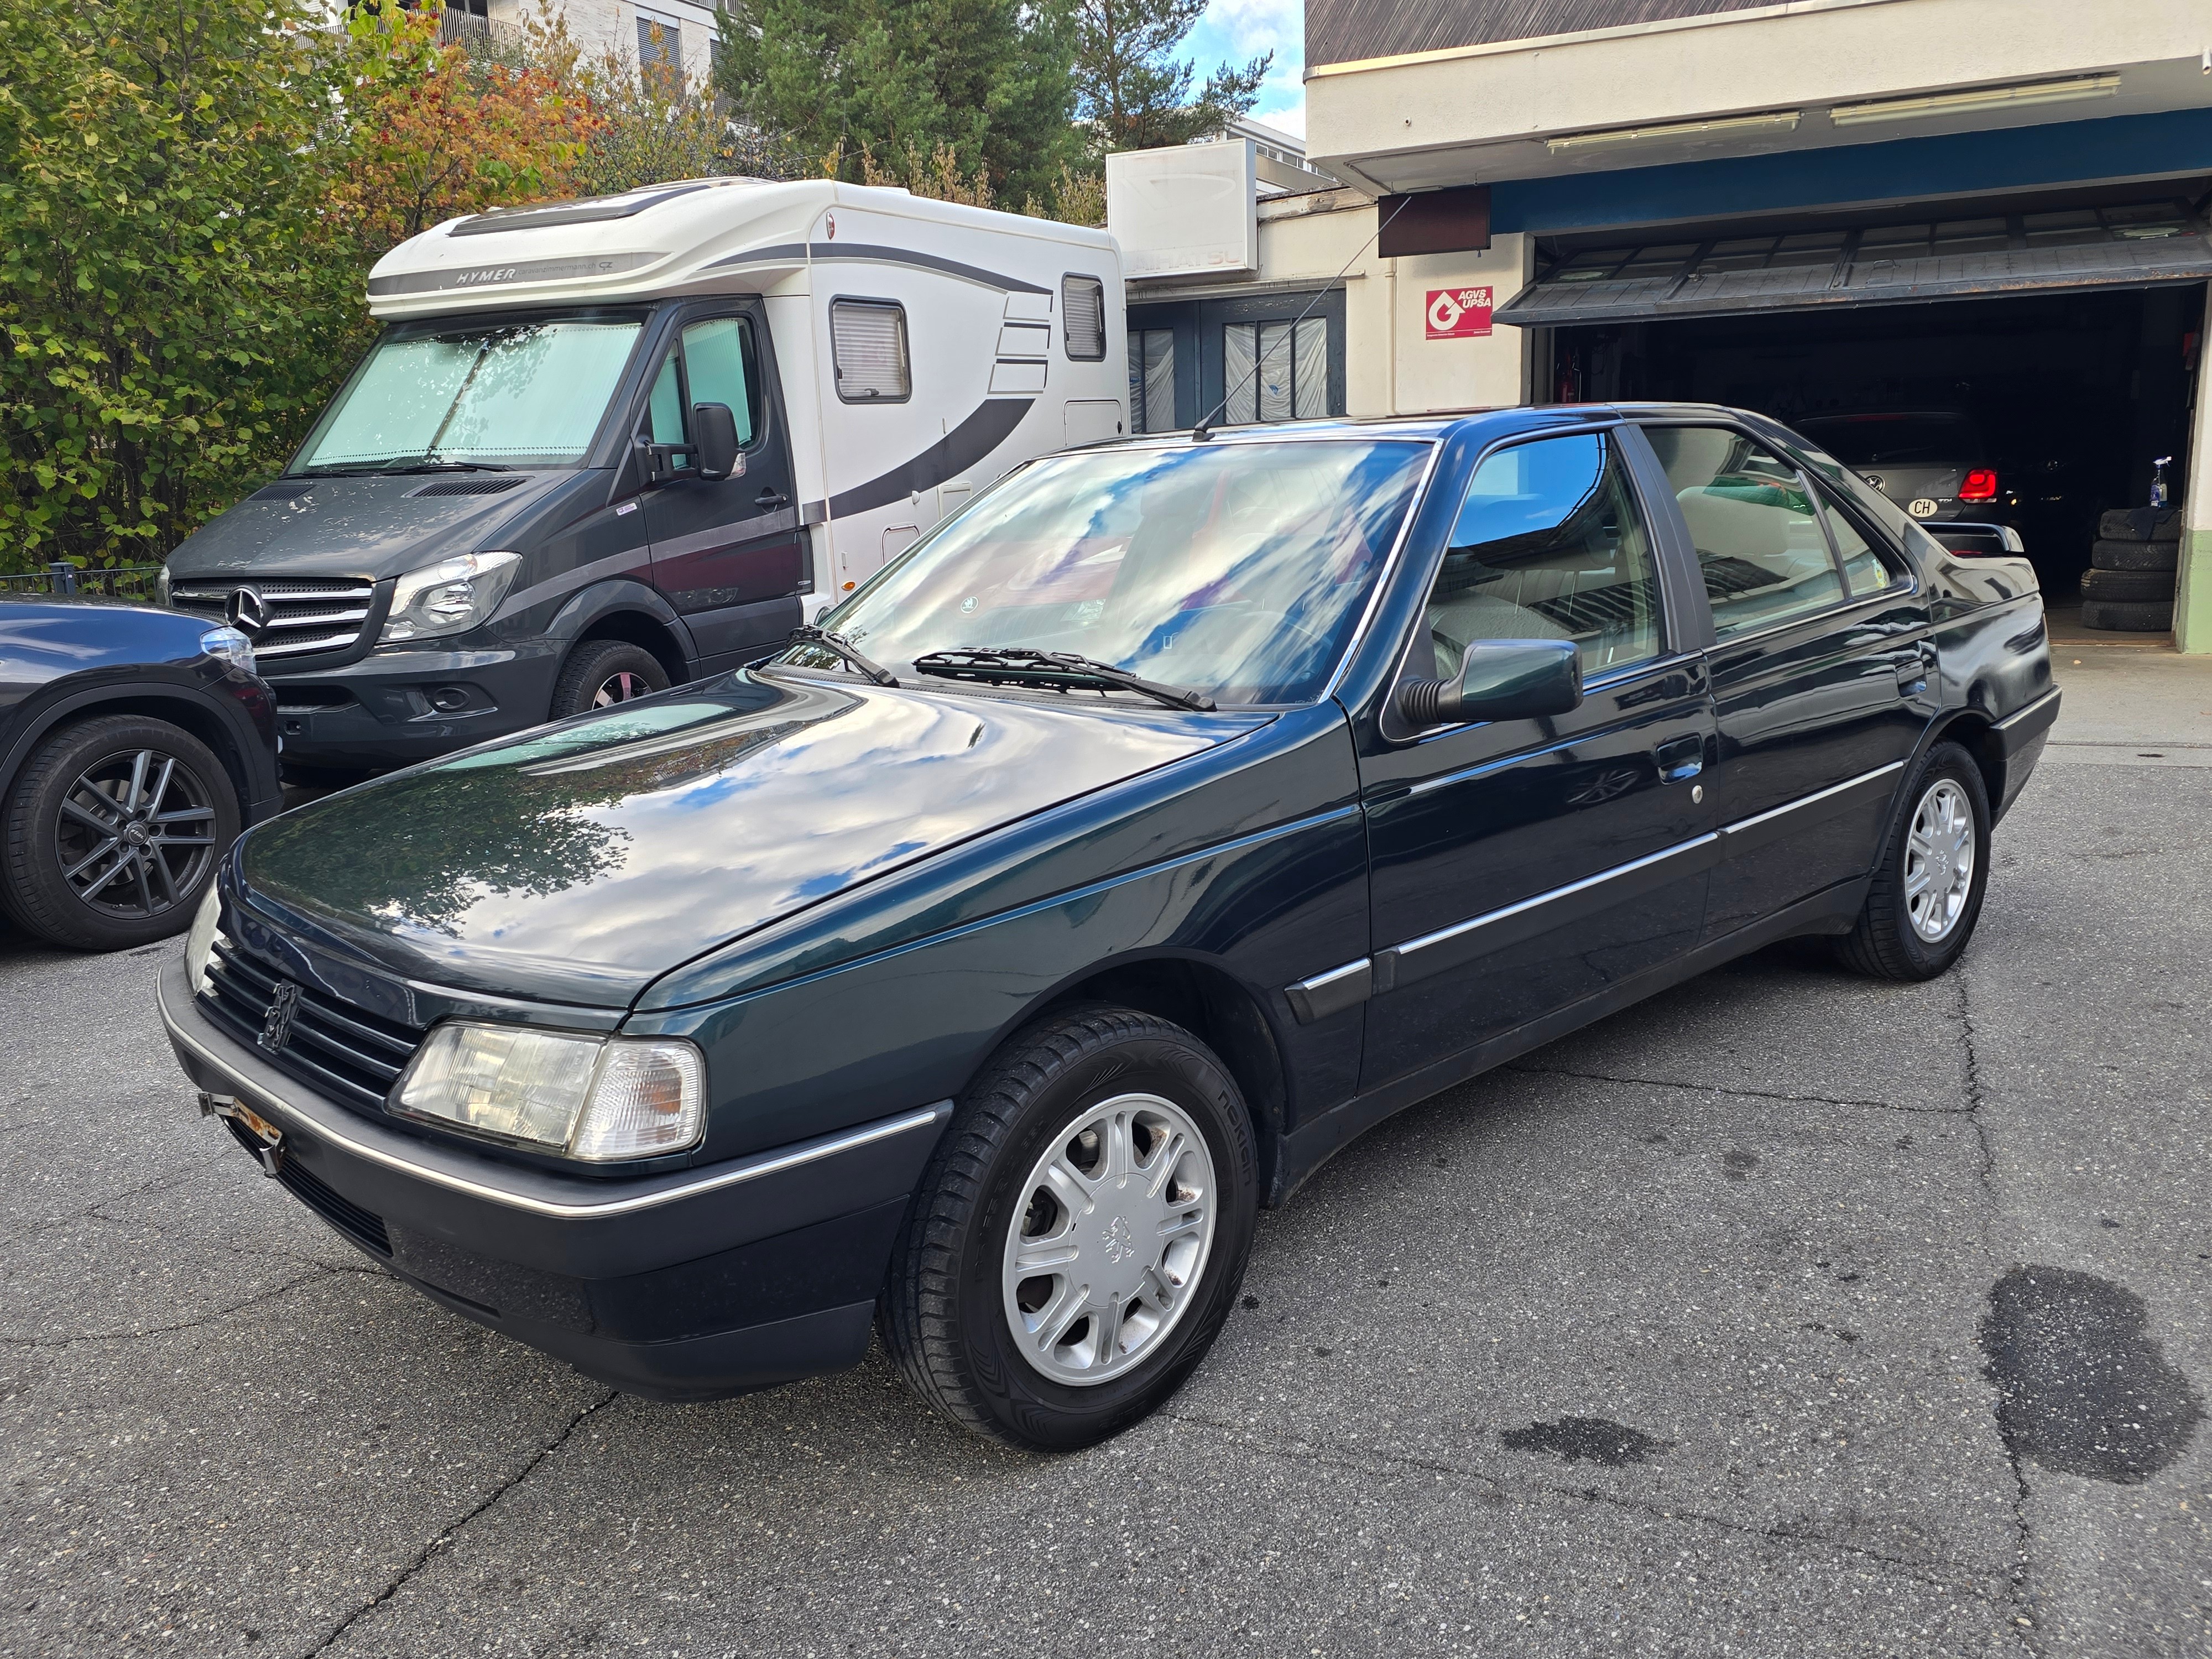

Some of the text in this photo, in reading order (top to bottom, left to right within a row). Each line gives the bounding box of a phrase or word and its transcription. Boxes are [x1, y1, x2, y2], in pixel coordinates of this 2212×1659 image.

[456, 268, 517, 285] HYMER
[518, 262, 596, 275] caravanzimmermann.ch
[1457, 289, 1487, 300] AGVS
[1462, 297, 1491, 308] UPSA
[1914, 501, 1931, 514] CH
[1217, 1089, 1252, 1186] nokian
